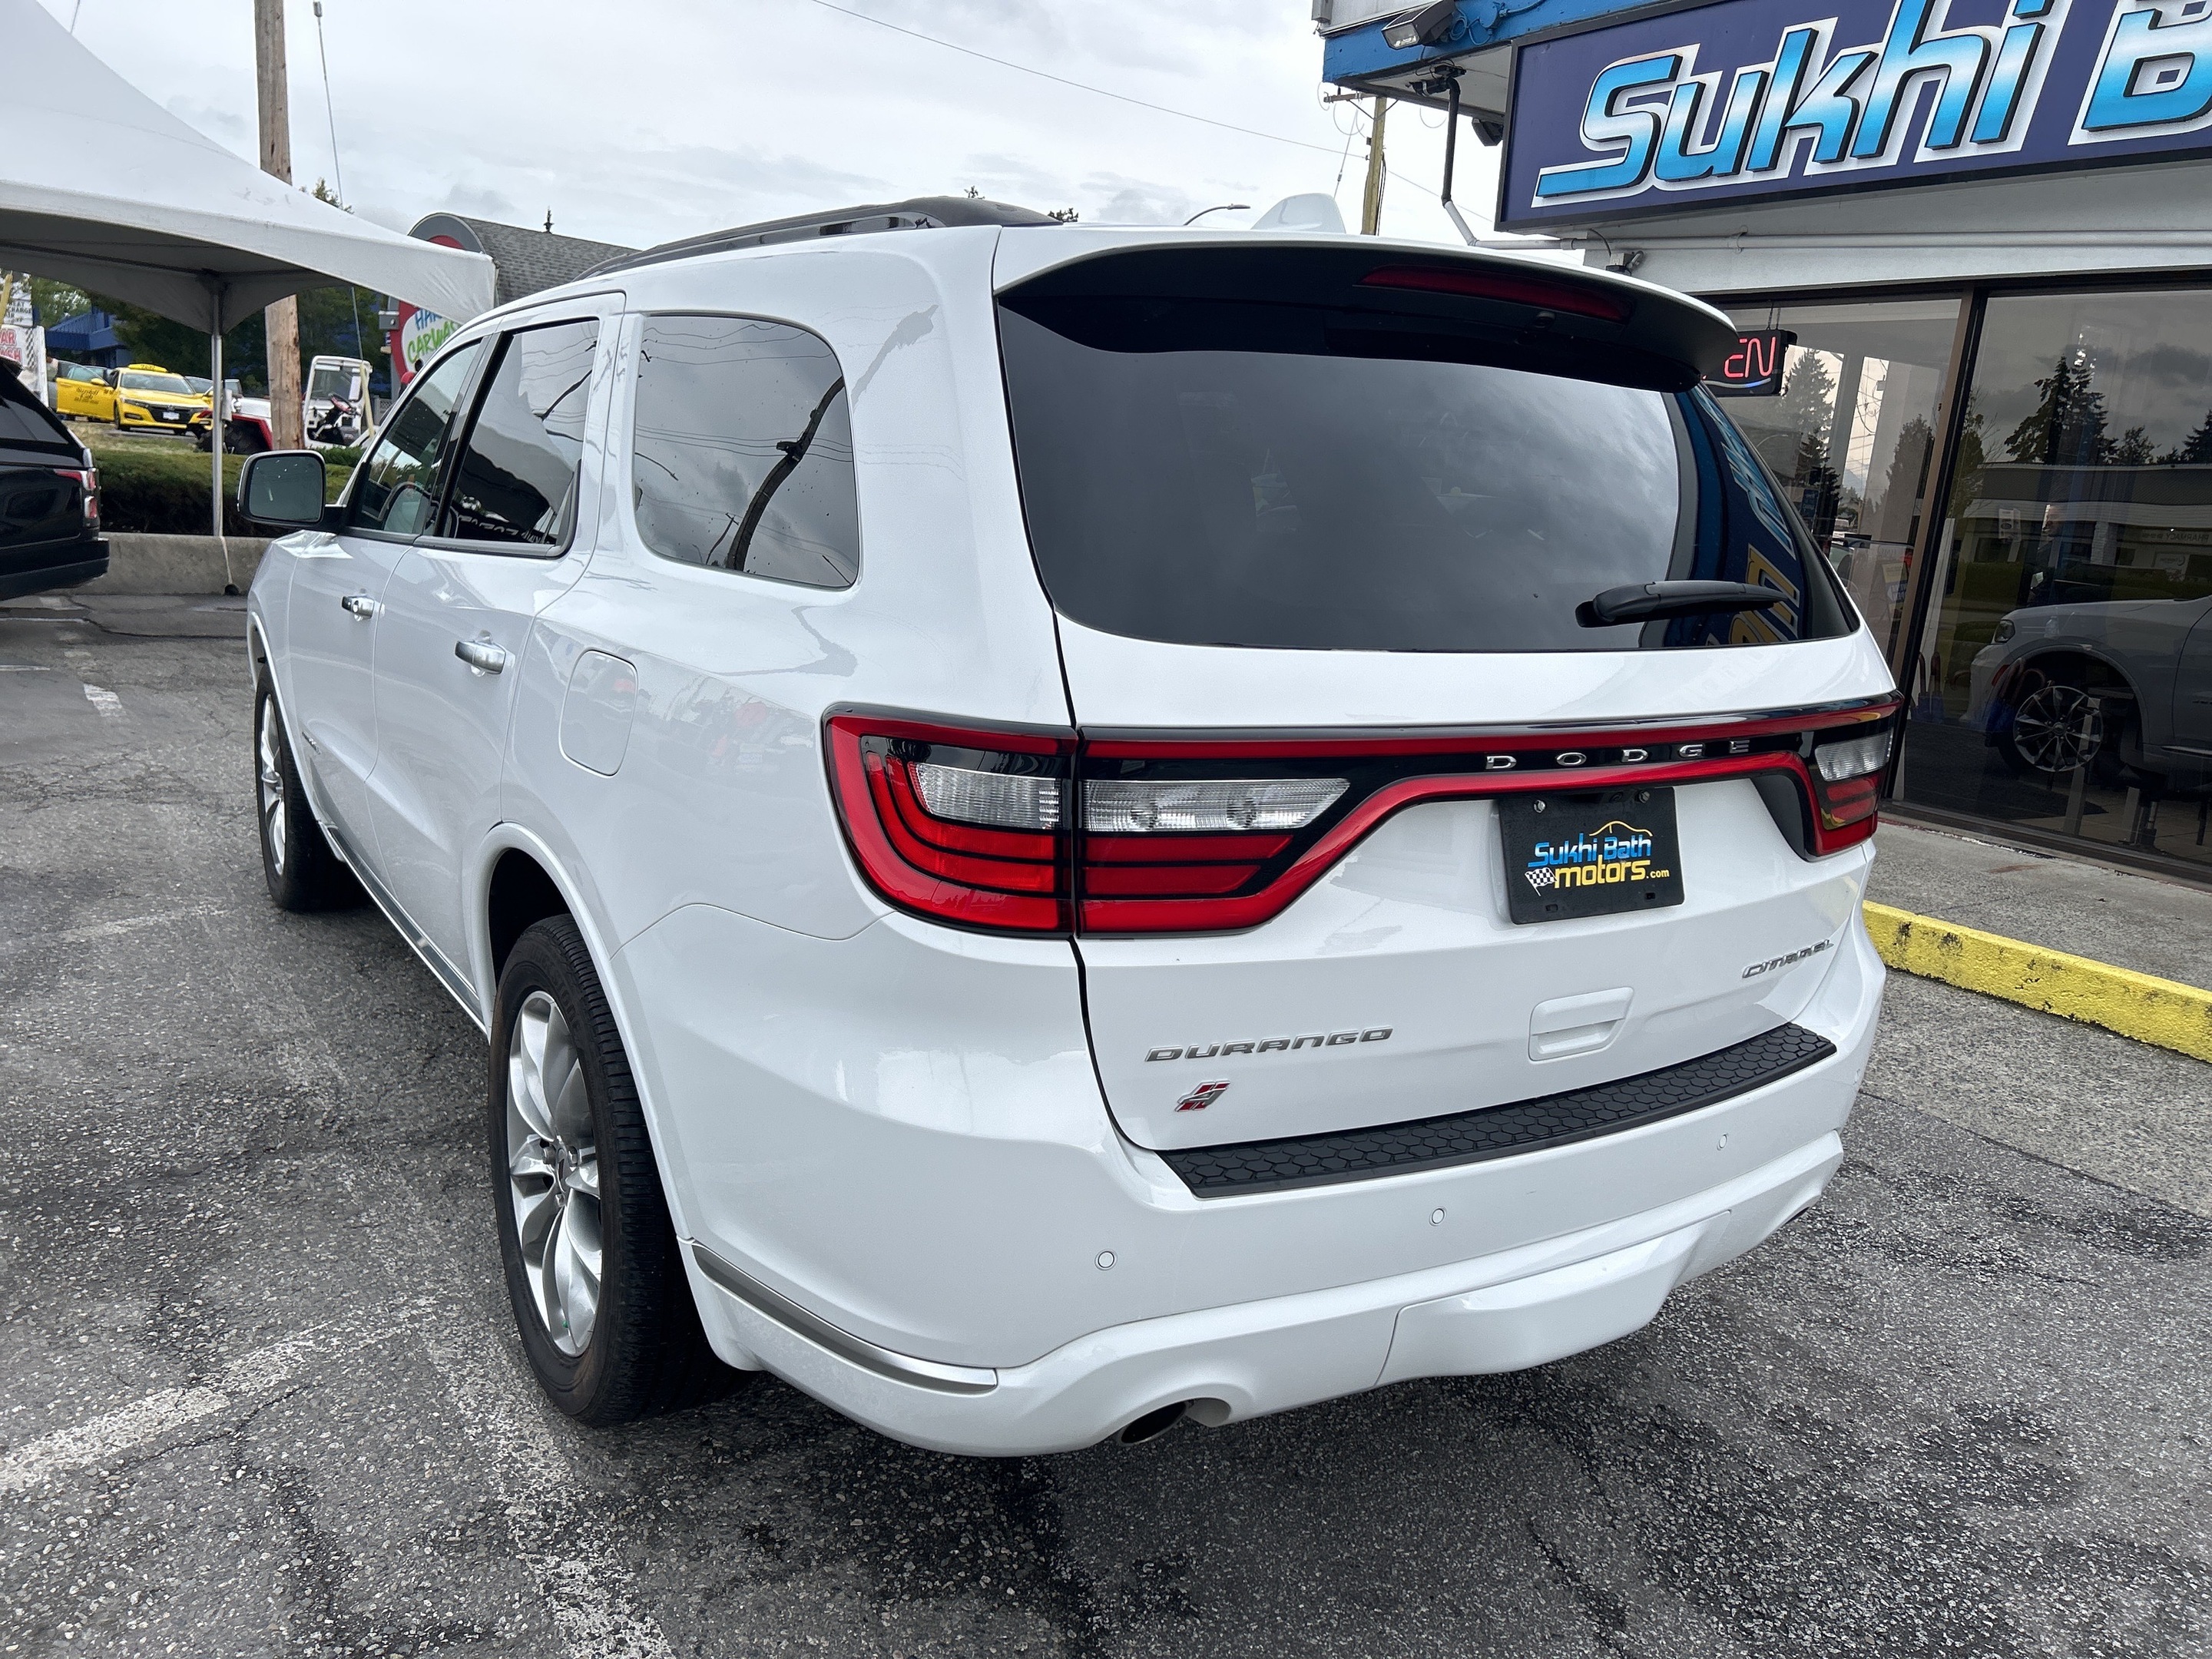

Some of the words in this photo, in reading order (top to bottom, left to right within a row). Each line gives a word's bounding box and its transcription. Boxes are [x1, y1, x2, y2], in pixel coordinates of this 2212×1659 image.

[1535, 0, 2055, 201] Sukhi
[0, 329, 16, 345] AR
[1724, 336, 1777, 378] EN
[1485, 740, 1750, 770] DODGE
[1528, 833, 1598, 868] Sukhi
[1604, 834, 1652, 860] Bath
[1742, 939, 1834, 979] CITADEL
[1144, 1025, 1394, 1062] DURANGO
